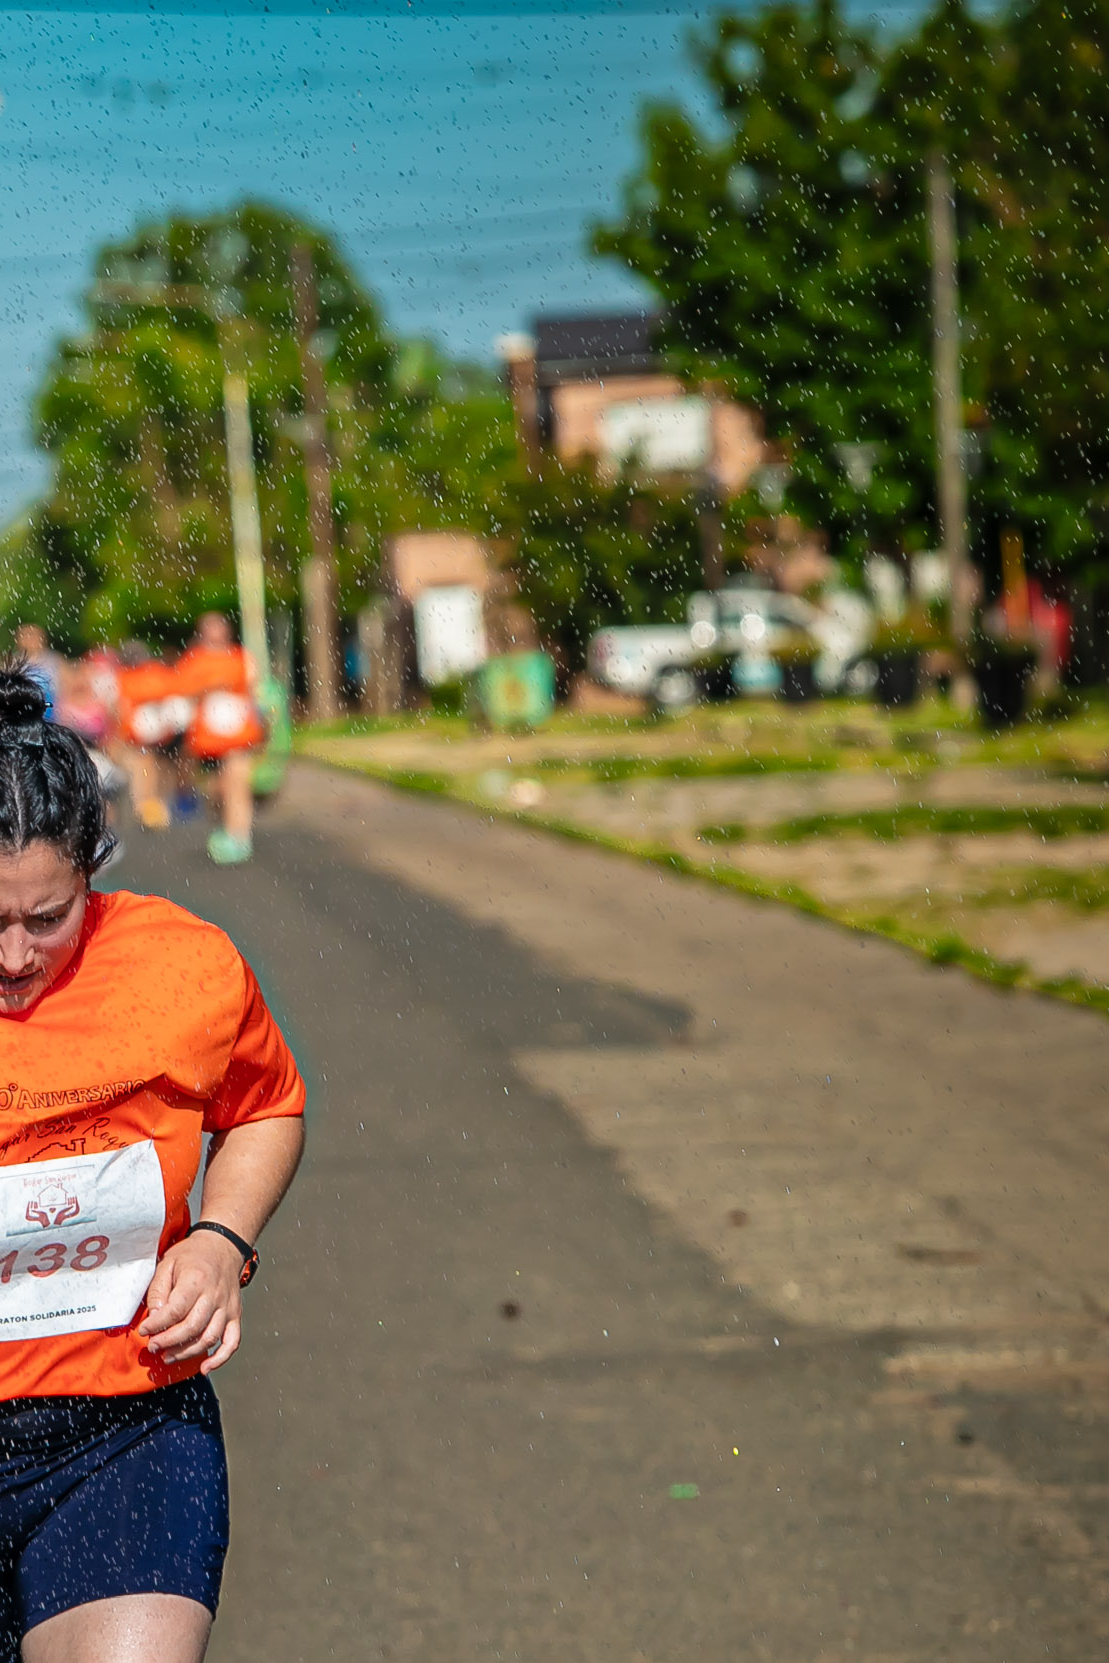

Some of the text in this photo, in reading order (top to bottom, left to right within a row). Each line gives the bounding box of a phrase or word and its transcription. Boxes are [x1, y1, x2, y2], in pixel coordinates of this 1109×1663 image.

[17, 1079, 147, 1110] ANIVERSARIO
[37, 1120, 77, 1139] San
[82, 1117, 130, 1151] Roqu
[29, 1308, 76, 1322] SOLIDARIA
[76, 1304, 98, 1314] 2025
